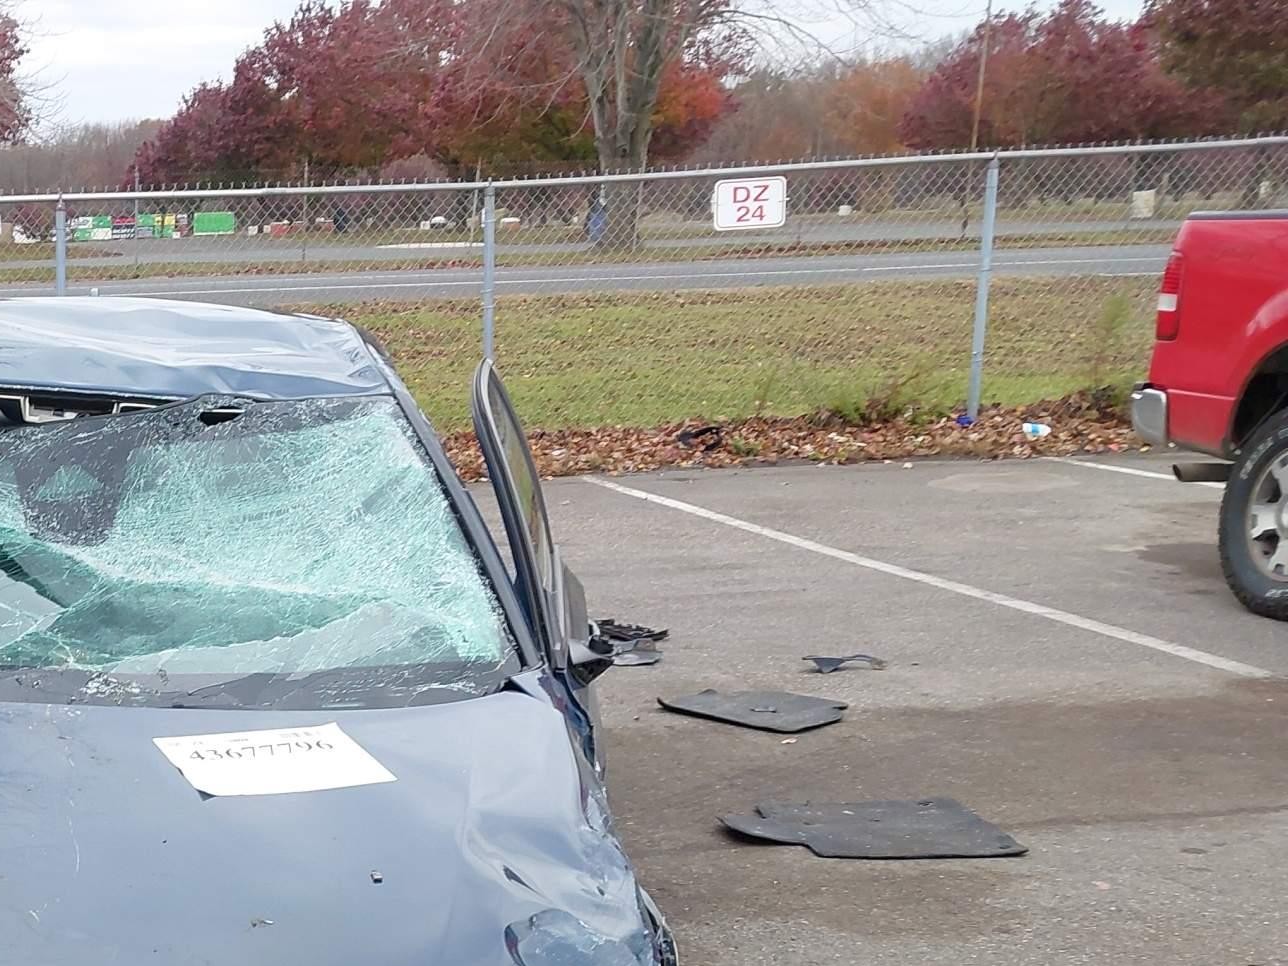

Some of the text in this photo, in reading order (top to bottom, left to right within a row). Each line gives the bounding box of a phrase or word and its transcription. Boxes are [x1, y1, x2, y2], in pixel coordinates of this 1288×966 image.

[733, 184, 770, 203] DZ
[736, 204, 767, 223] 24
[189, 739, 334, 761] 43677796
